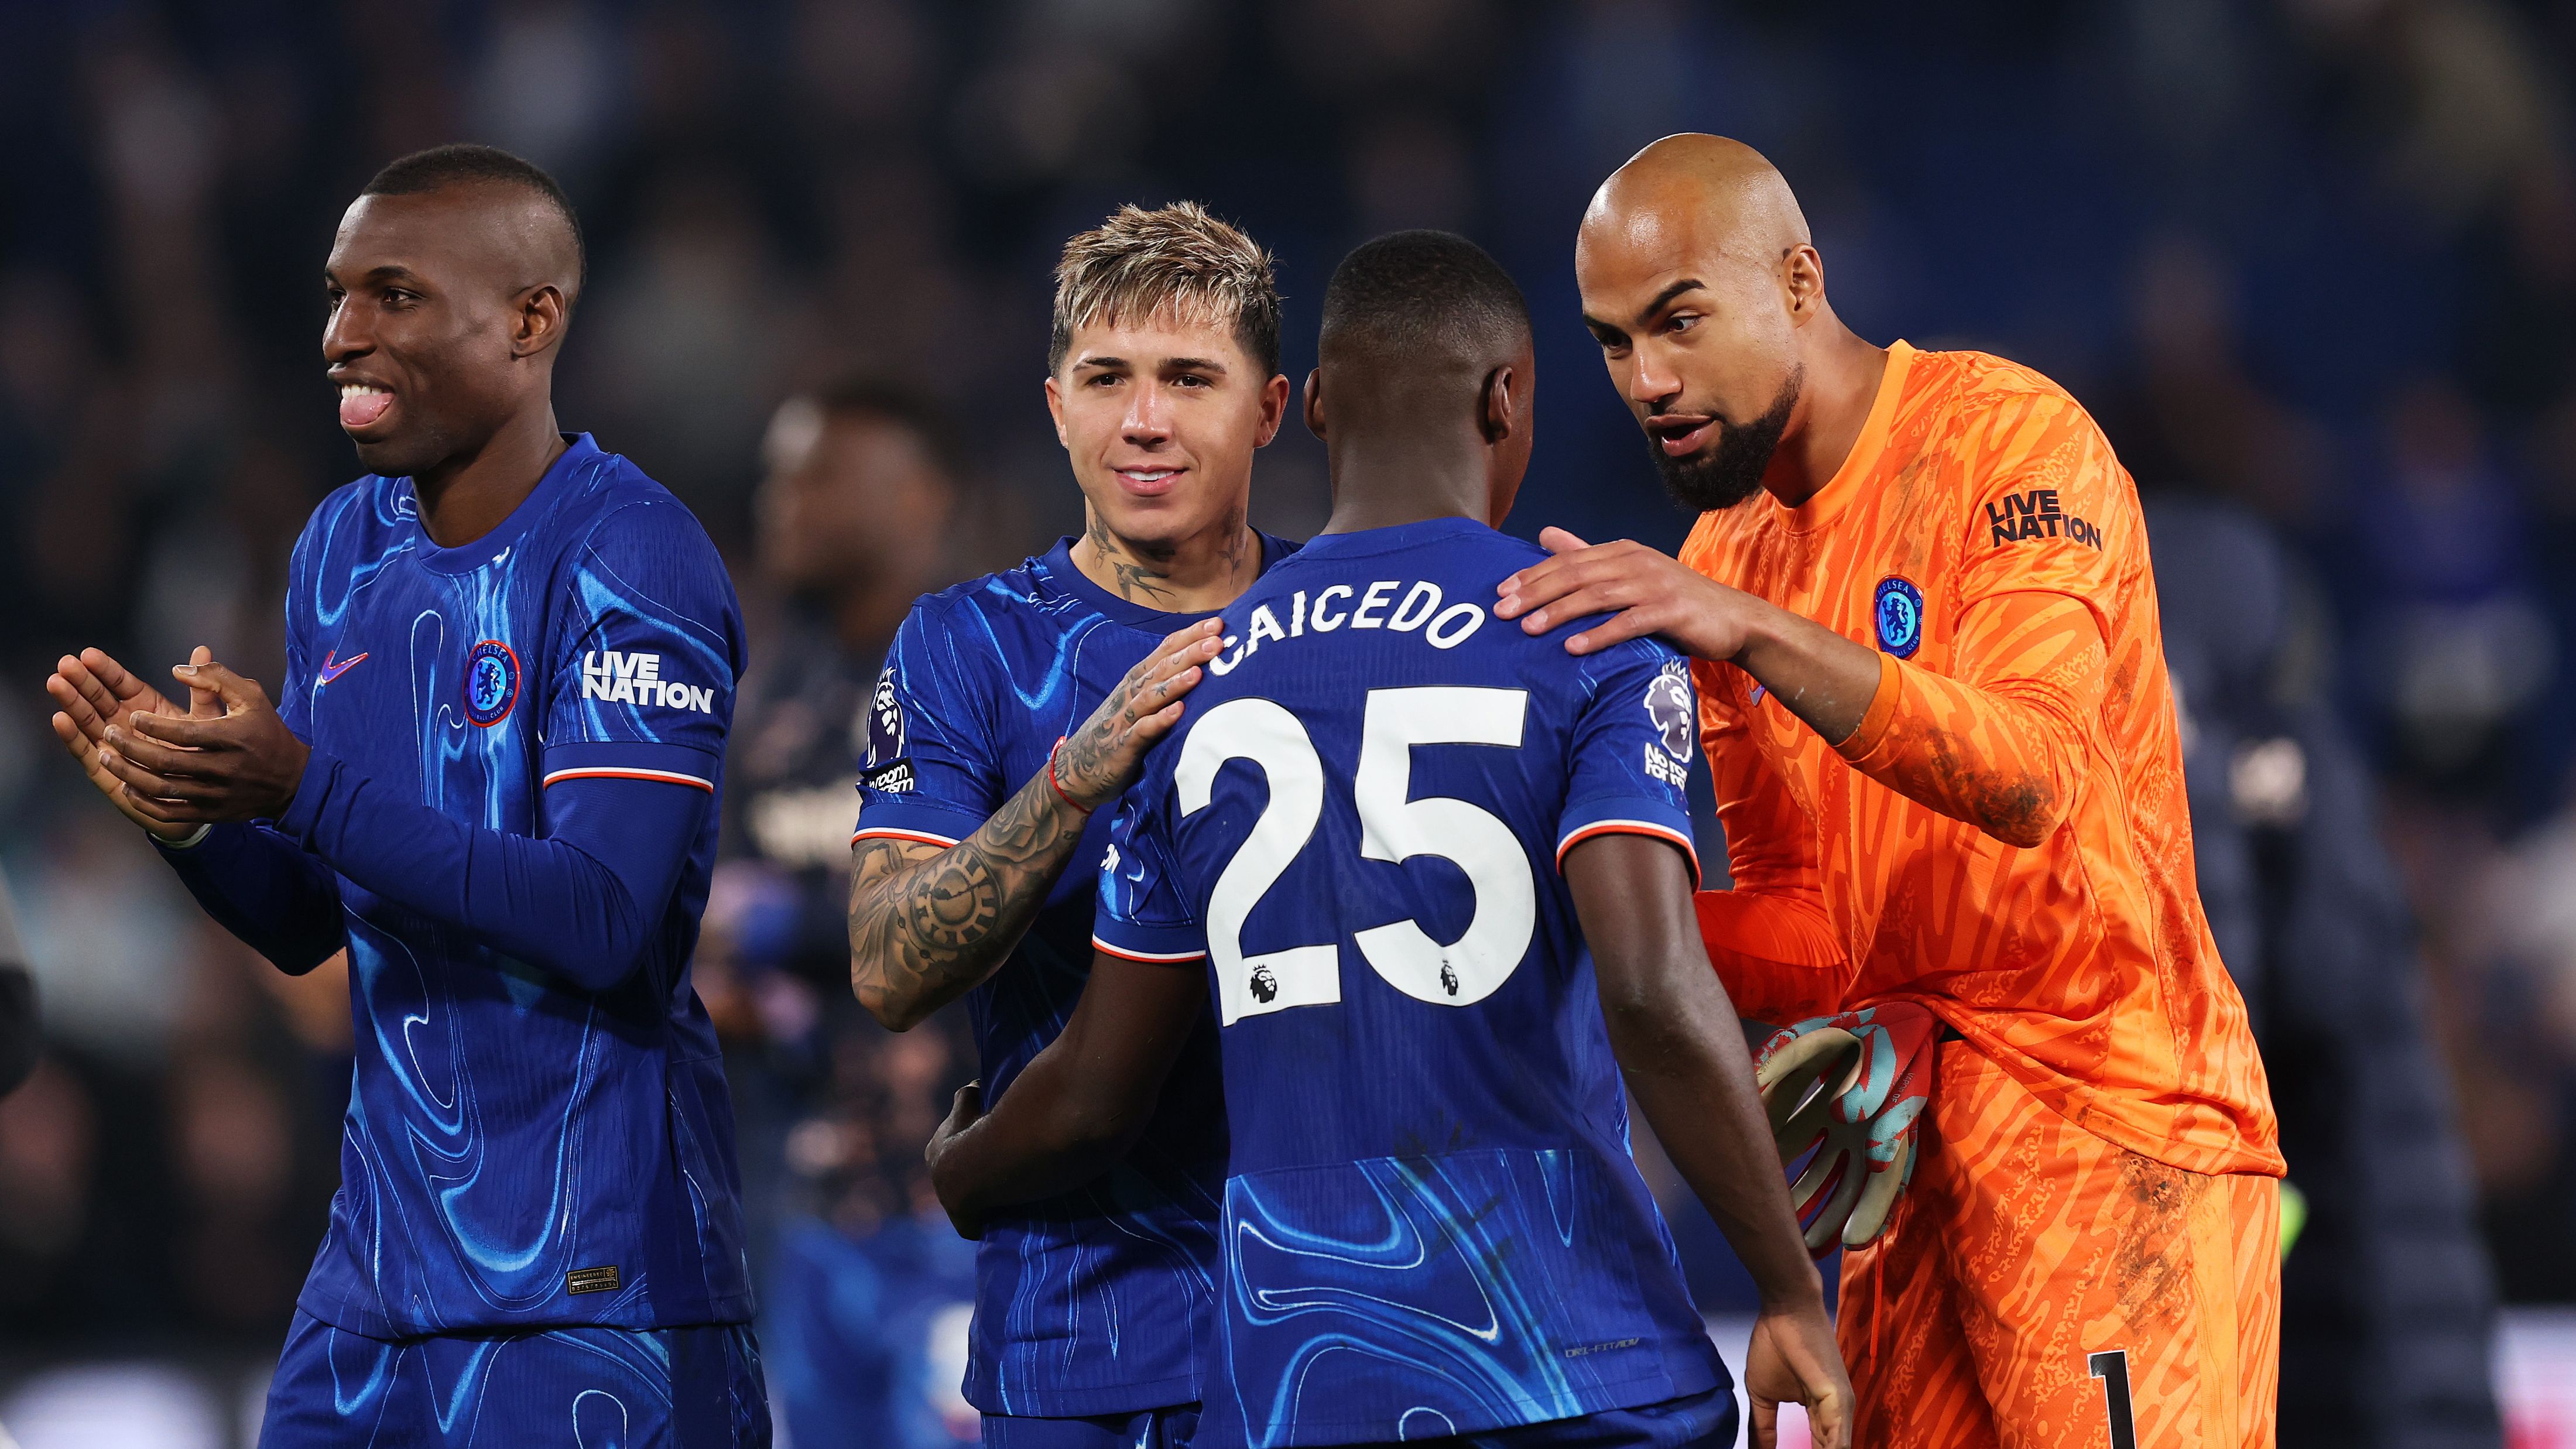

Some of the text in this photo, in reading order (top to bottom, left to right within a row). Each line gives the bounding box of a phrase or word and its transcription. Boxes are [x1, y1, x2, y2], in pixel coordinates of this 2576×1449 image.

[1985, 490, 2061, 526] LIVE
[1991, 513, 2102, 552] NATION
[1209, 580, 1486, 677] CAICEDO
[1907, 635, 1920, 650] CLUB
[472, 645, 509, 663] CHELSEA
[583, 650, 660, 680] LIVE
[490, 705, 504, 718] CLUB
[582, 674, 714, 714] NATION
[875, 764, 908, 789] room
[1174, 686, 1537, 1027] 25
[2087, 1349, 2137, 1449] 1
